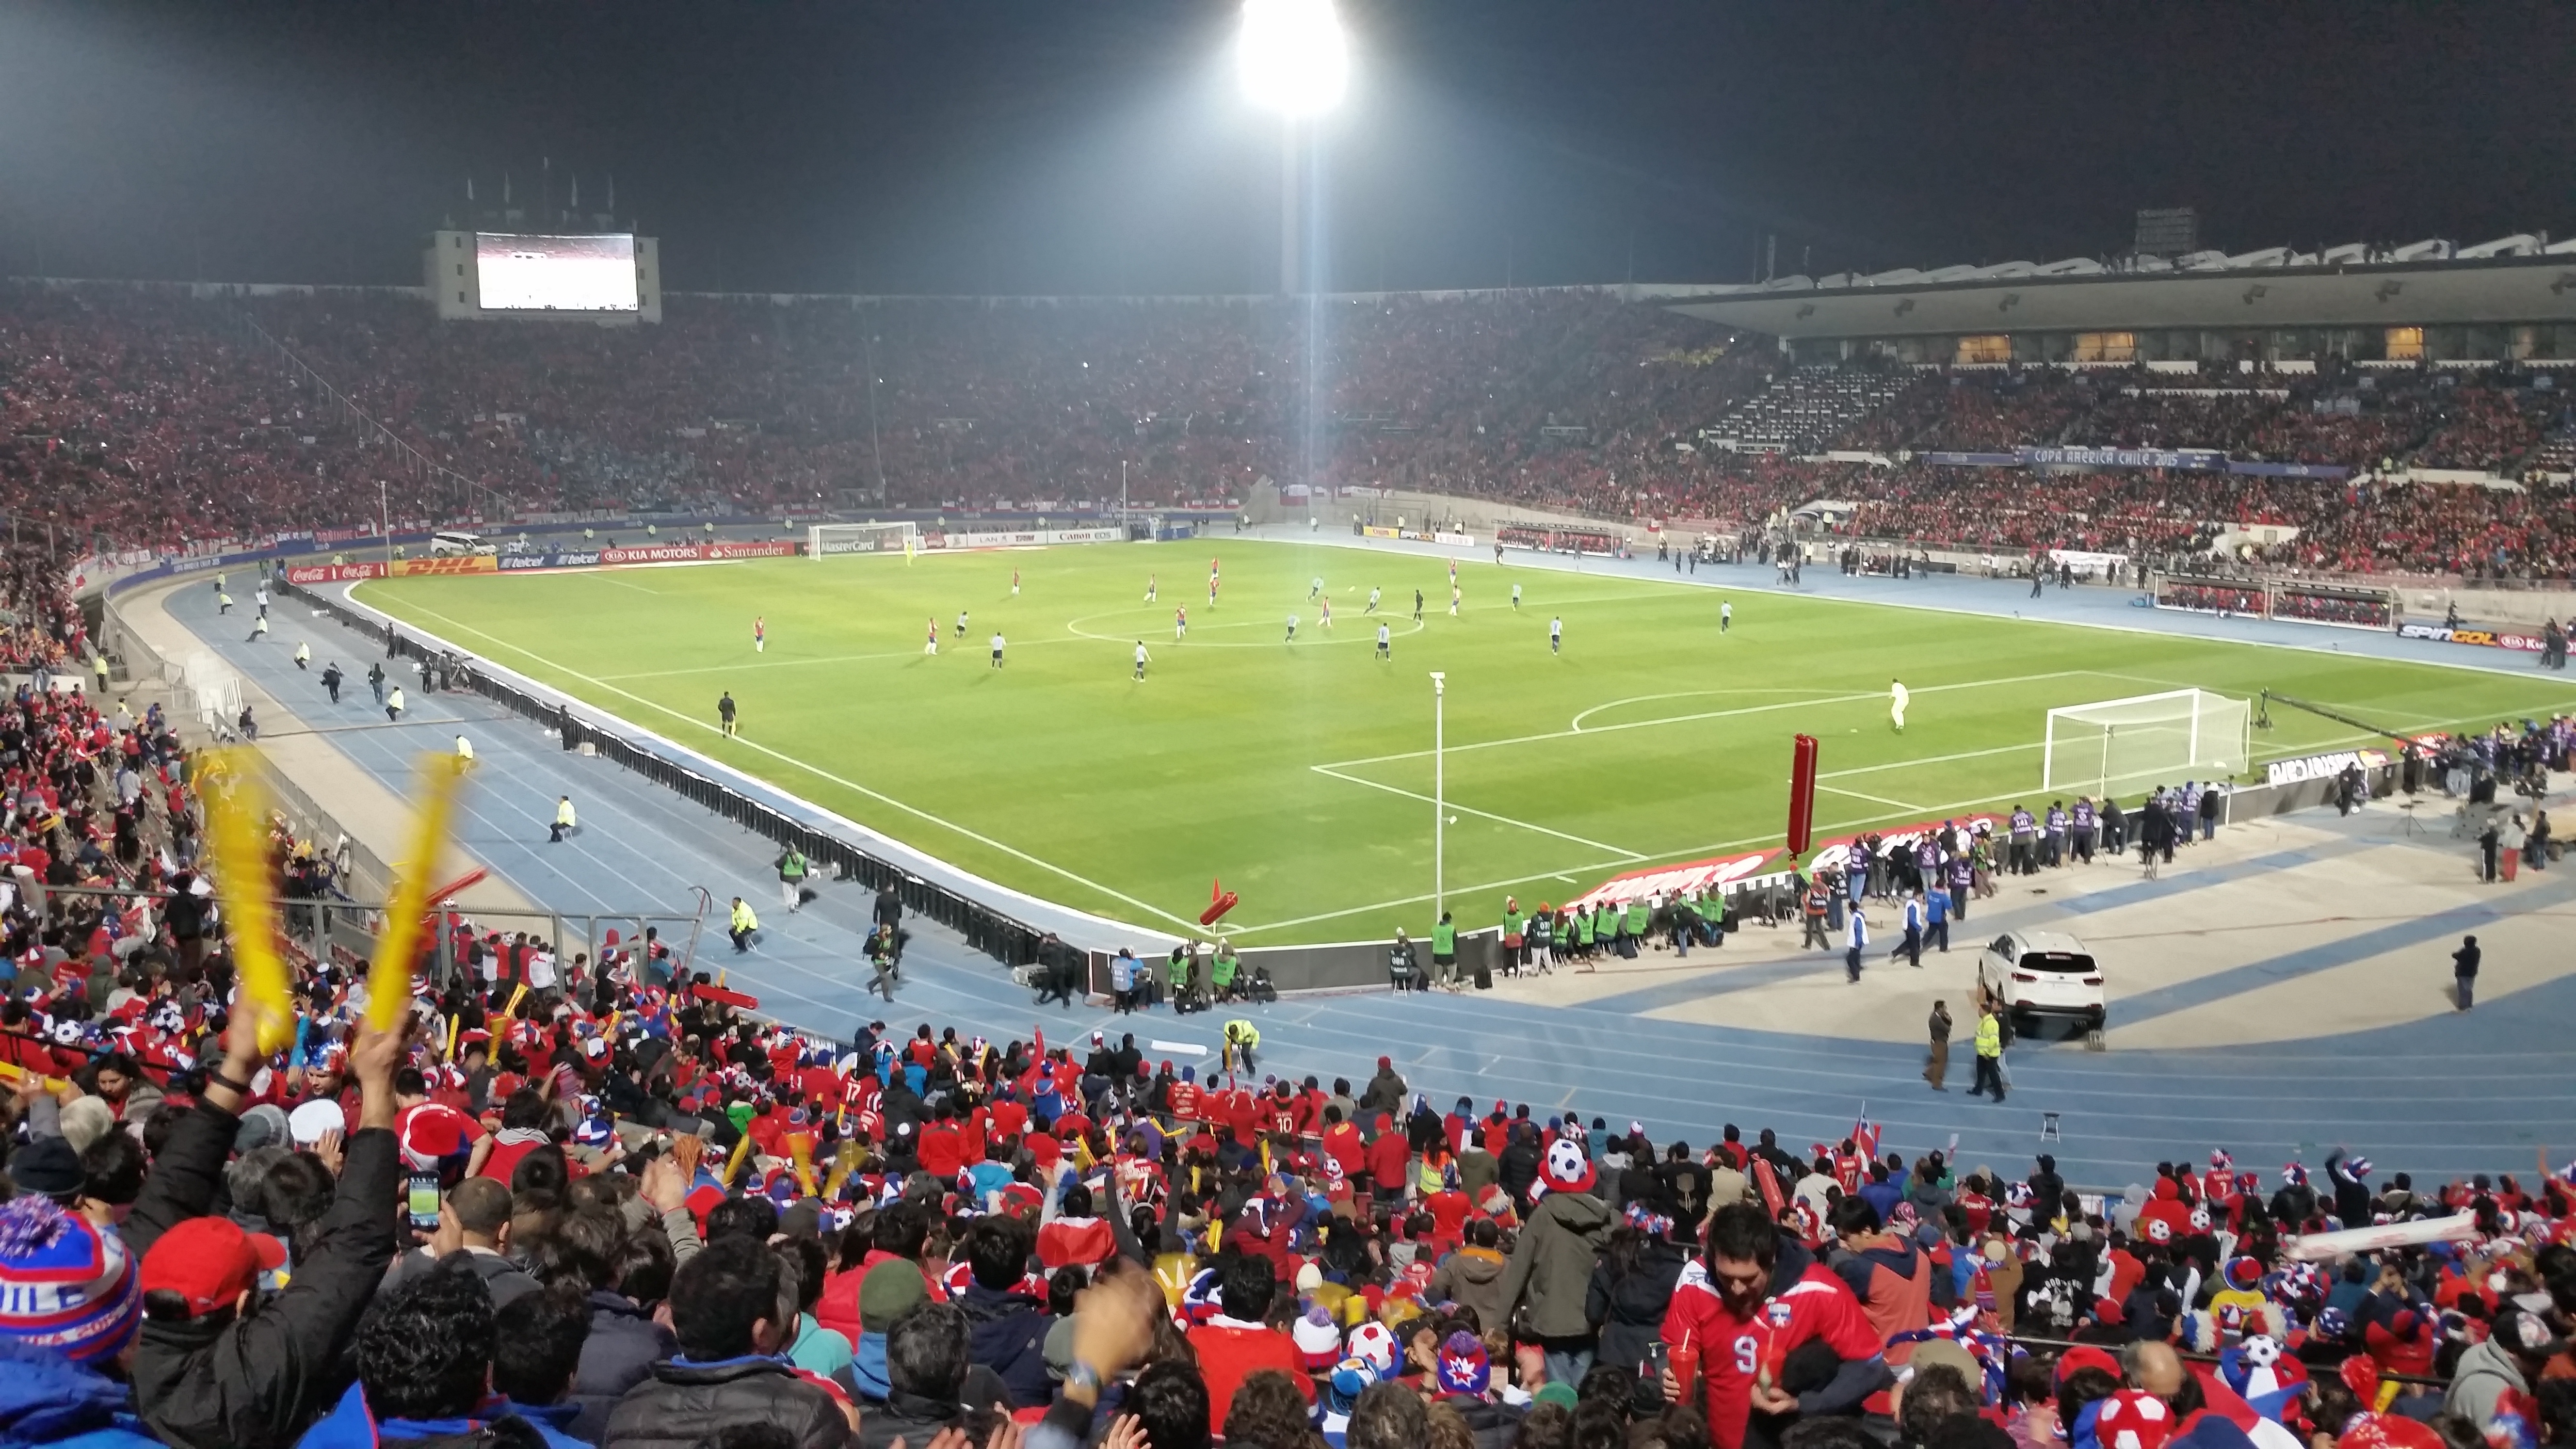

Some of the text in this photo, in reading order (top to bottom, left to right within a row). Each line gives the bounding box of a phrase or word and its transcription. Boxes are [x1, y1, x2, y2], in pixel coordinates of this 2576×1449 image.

[2035, 450, 2061, 463] COPA
[2067, 451, 2113, 464] AMERICA
[2155, 453, 2178, 467] 2015
[1059, 532, 1091, 541] Canon
[628, 550, 647, 561] KIA
[651, 547, 698, 560] MOTORS
[724, 543, 785, 558] Santander
[821, 540, 874, 552] MasterCard
[404, 557, 483, 574] DHL
[846, 1081, 861, 1103] 17
[1276, 1117, 1292, 1133] 10
[1734, 1335, 1758, 1374] 9
